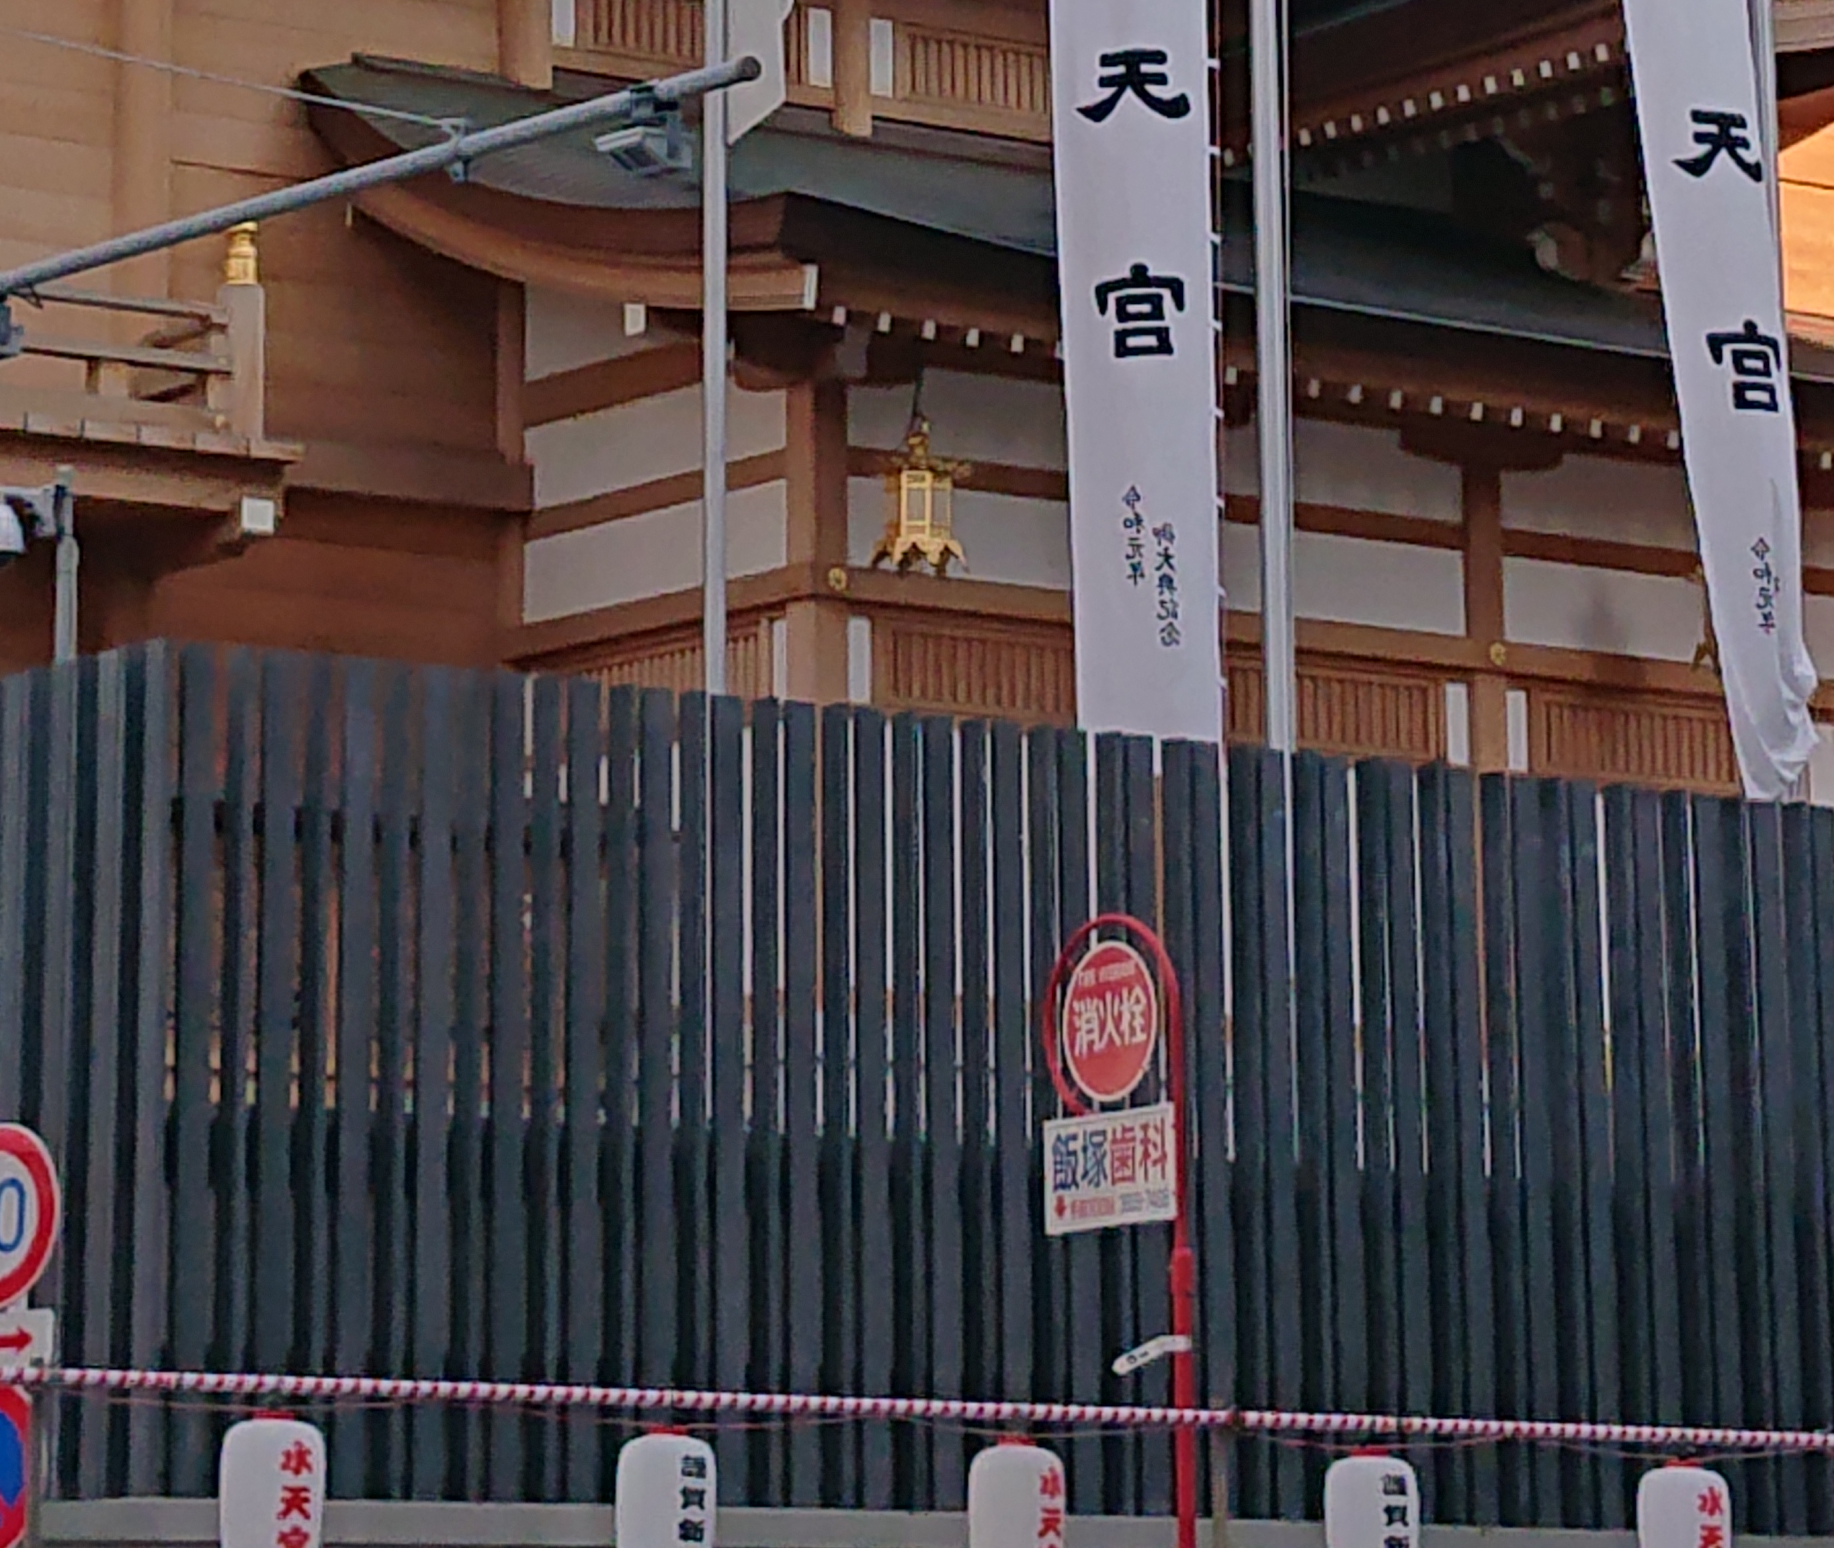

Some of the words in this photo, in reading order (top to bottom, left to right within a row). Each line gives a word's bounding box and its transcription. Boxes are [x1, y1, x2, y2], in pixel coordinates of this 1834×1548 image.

[1072, 984, 1147, 1059] 消火栓
[1051, 1116, 1168, 1194] 飯塚歯科
[1037, 1466, 1062, 1548] 水天
